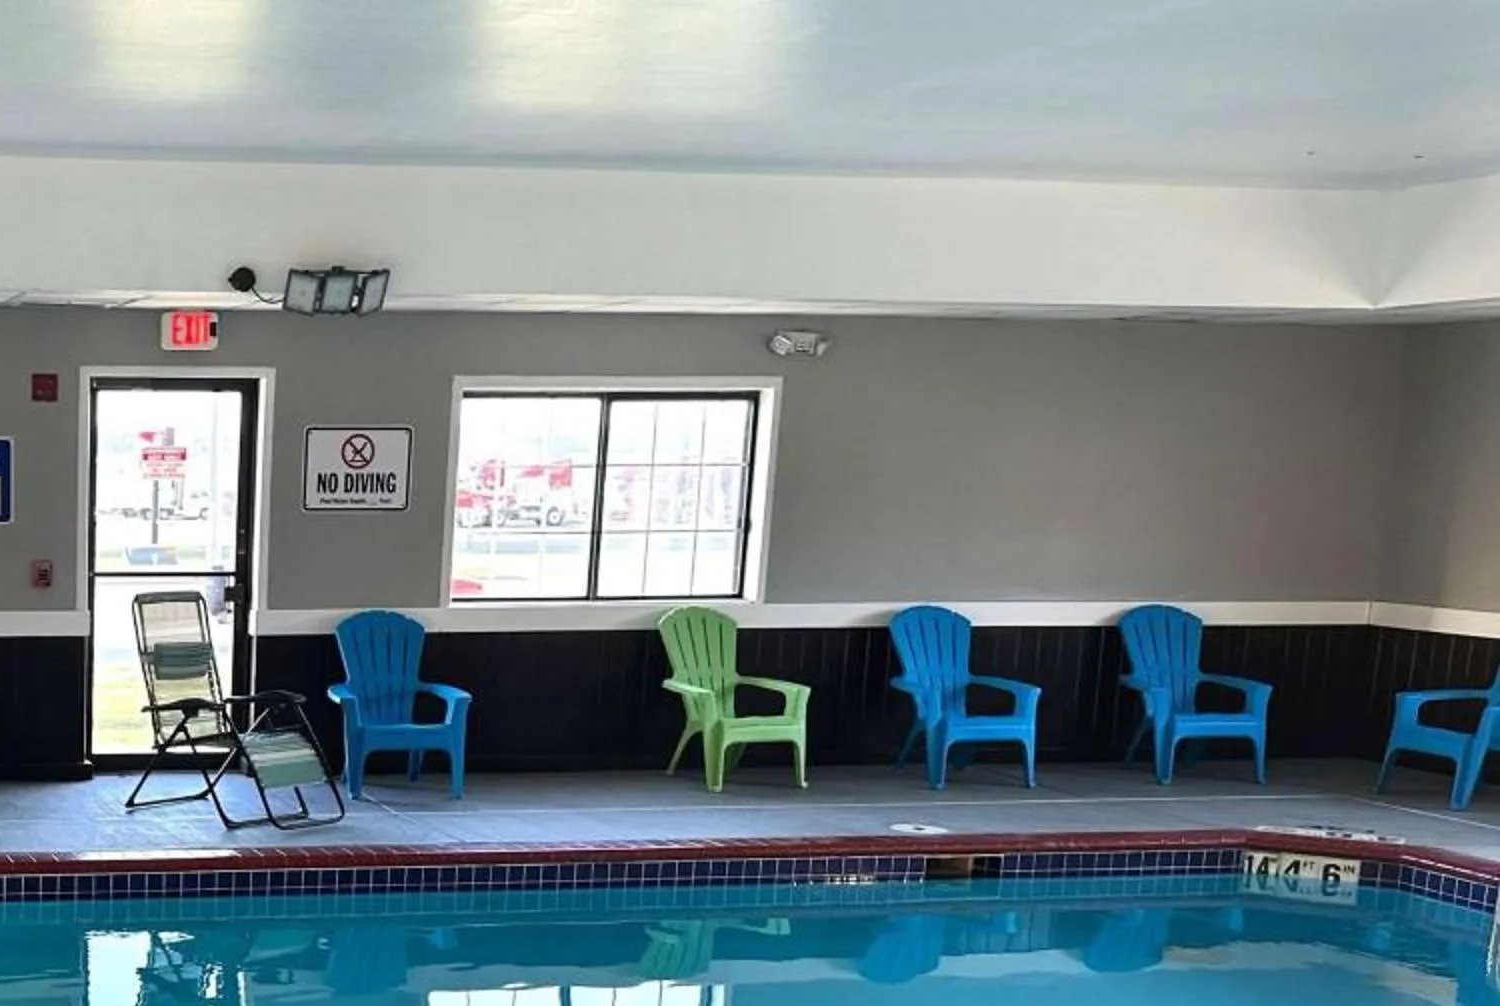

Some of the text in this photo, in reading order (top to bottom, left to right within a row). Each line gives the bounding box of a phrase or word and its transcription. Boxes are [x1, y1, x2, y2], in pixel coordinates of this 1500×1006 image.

[171, 312, 211, 345] EXIT
[316, 472, 397, 494] NO DIVING
[1322, 863, 1341, 883] 6
